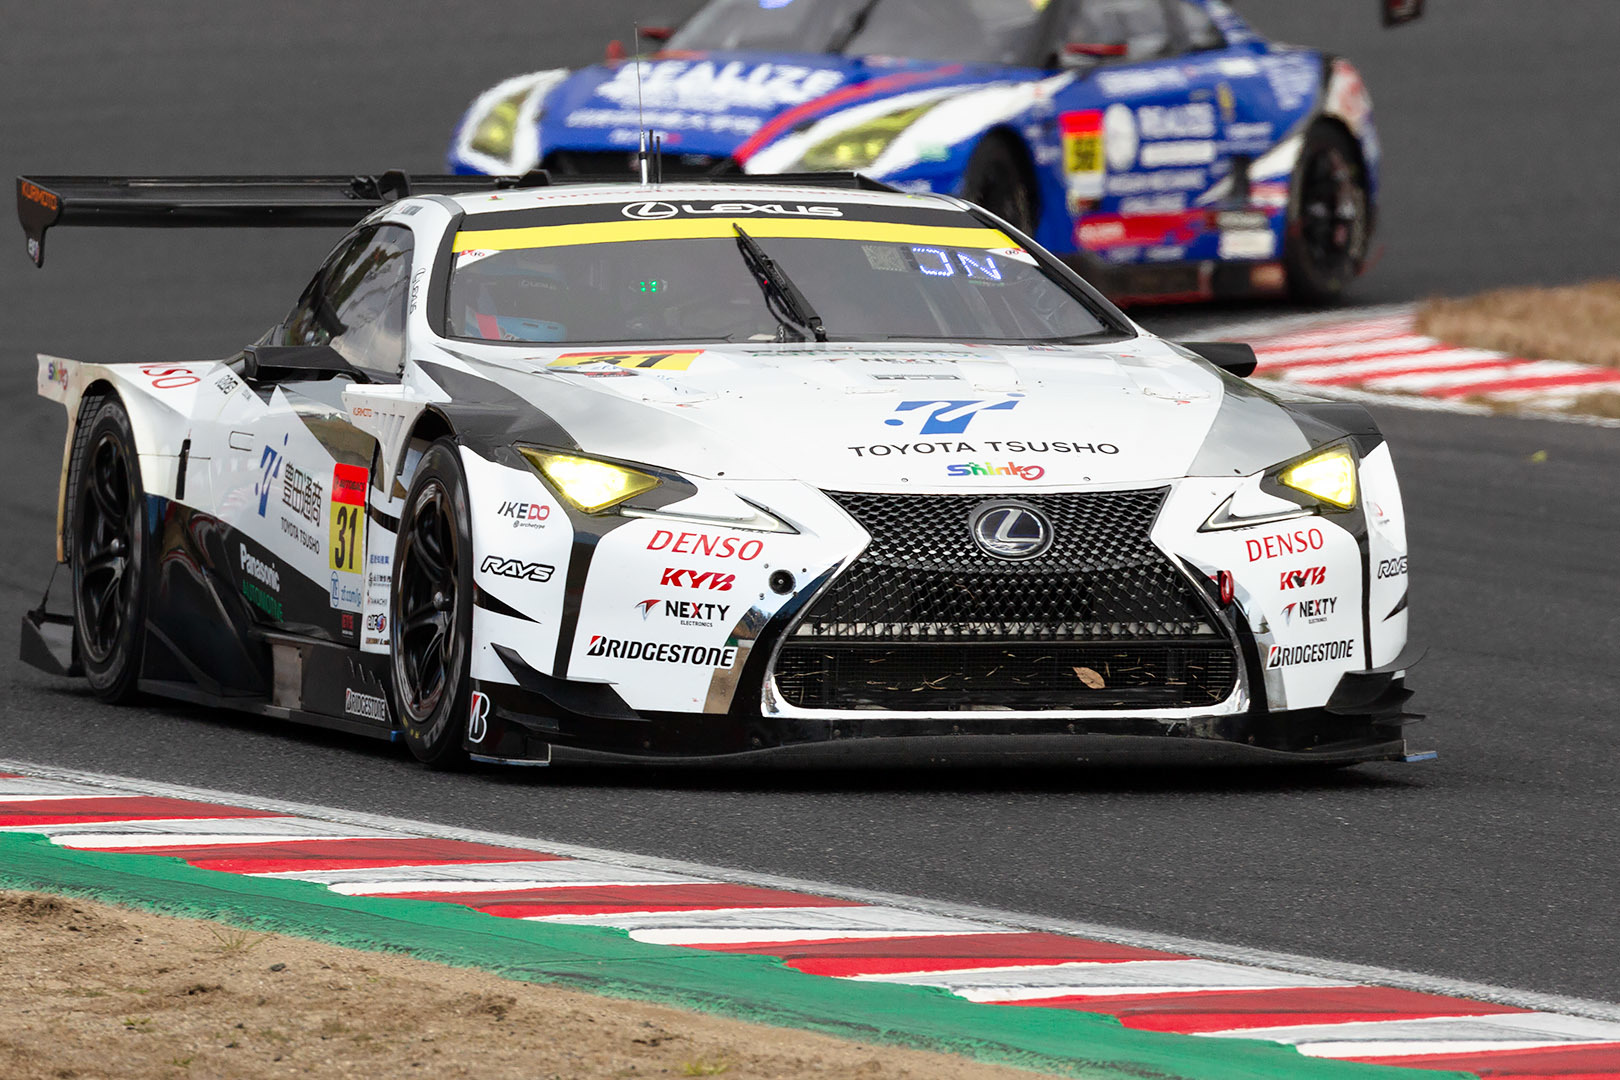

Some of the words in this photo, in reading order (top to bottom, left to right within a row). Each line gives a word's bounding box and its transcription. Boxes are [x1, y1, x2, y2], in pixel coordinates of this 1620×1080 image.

[682, 203, 844, 217] LEXUS
[848, 442, 977, 457] TOYOTA
[984, 441, 1120, 455] TSUSHO
[497, 501, 550, 521] IKEDO
[280, 516, 300, 542] TOYOTA
[300, 529, 321, 555] TSUSHO
[334, 505, 358, 569] 31
[646, 529, 764, 561] DENSO
[1246, 528, 1324, 562] DENSO
[239, 542, 280, 592] Panasonic
[481, 555, 555, 582] RAYS
[660, 567, 737, 592] KYB
[1280, 565, 1327, 590] KYB
[1377, 555, 1408, 579] RAYS
[665, 600, 731, 621] NEXTY
[1299, 597, 1338, 618] NEXTY
[680, 619, 713, 628] ELECTRONICS
[587, 635, 735, 667] BRIDGESTONE
[1269, 639, 1354, 668] BRIDGESTONE
[345, 688, 386, 721] BRIDGESTONE
